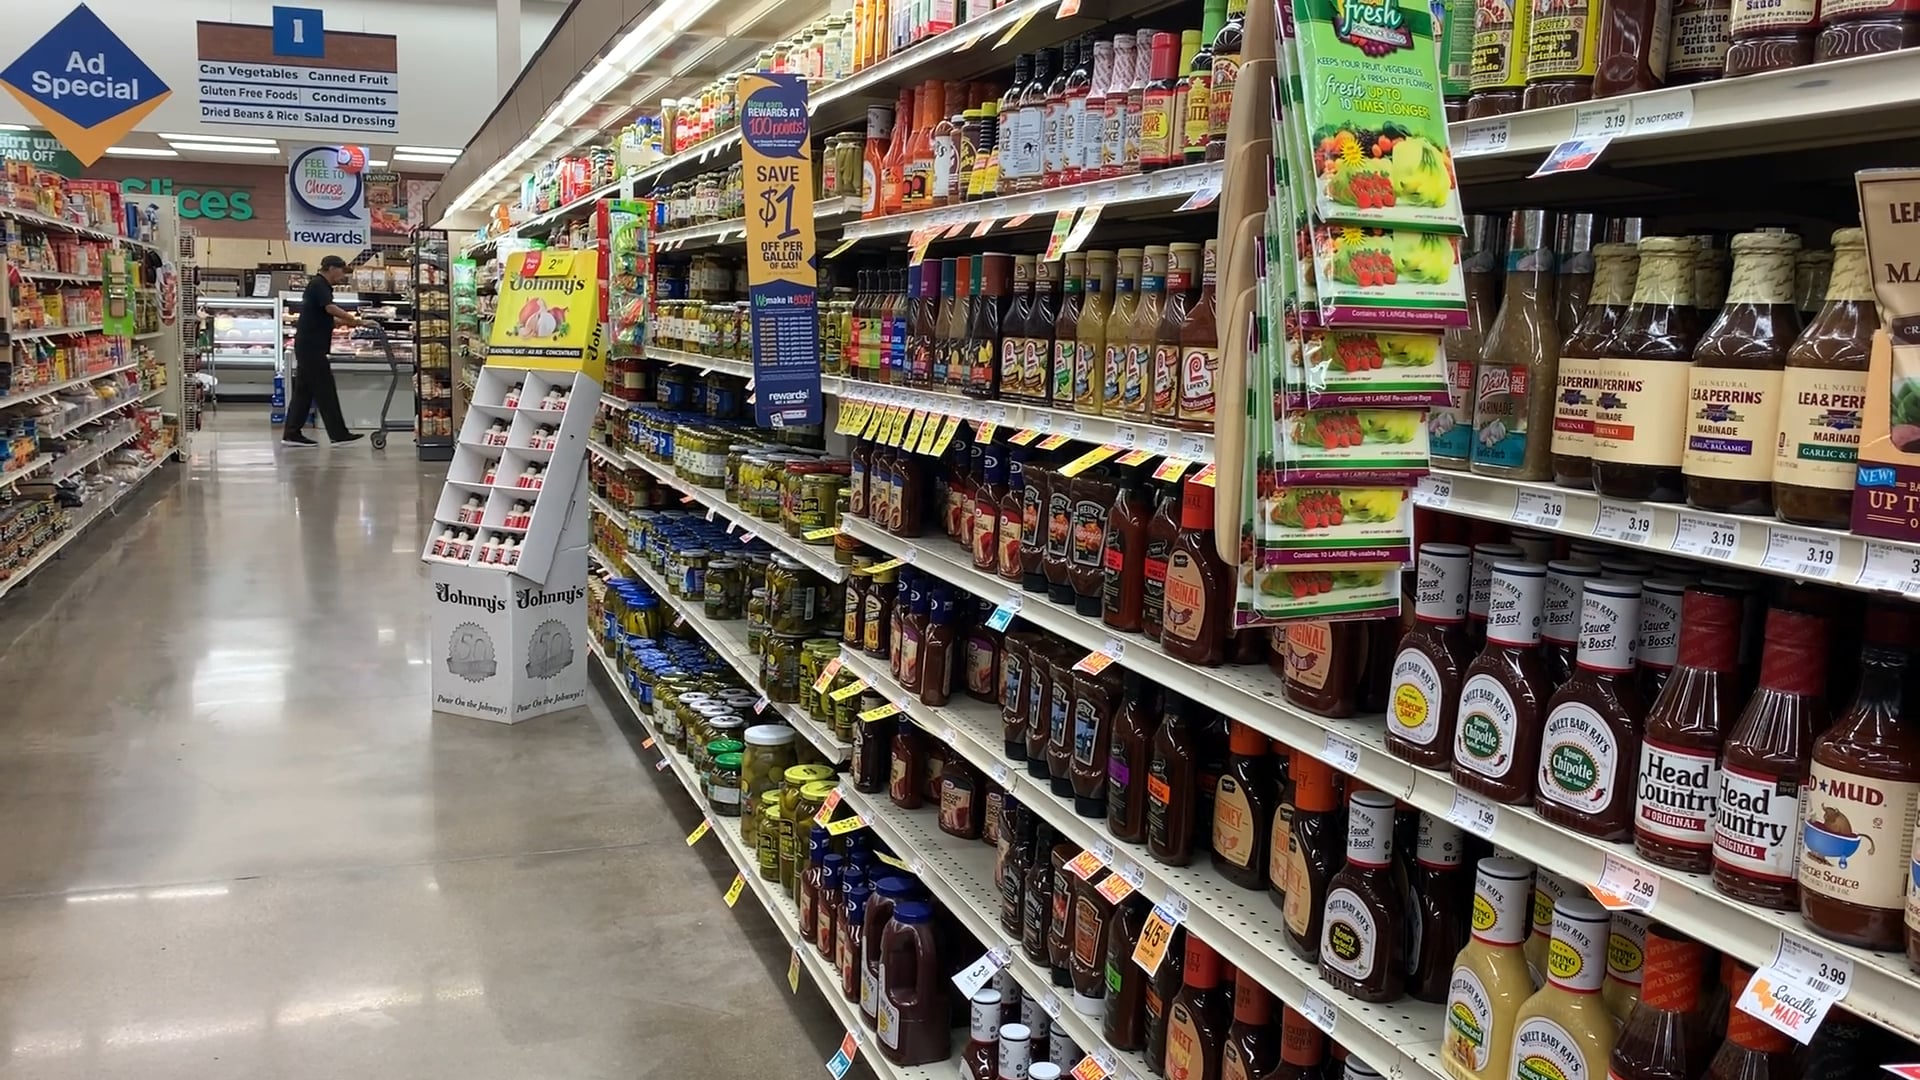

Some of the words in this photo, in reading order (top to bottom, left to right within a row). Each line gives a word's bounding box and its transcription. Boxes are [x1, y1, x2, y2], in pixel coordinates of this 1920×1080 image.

[1342, 0, 1401, 33] fresh
[1684, 46, 1716, 55] Sauce
[65, 51, 105, 74] Ad
[1317, 57, 1339, 66] KEEPS
[1341, 58, 1361, 68] YOUR
[1384, 64, 1423, 76] VEGETABLES
[200, 64, 226, 76] Can
[228, 66, 299, 80] Vegetables
[308, 71, 355, 84] Canned
[358, 74, 389, 86] Fruit
[32, 70, 139, 101] Special
[1322, 74, 1365, 104] fresh
[1367, 87, 1383, 98] UP
[1385, 88, 1402, 100] TO
[1367, 74, 1389, 84] FRESH
[1391, 76, 1404, 86] CUT
[1405, 78, 1434, 91] FLOWERS
[200, 86, 236, 98] Gluten
[239, 88, 262, 98] Free
[265, 89, 299, 101] Foods
[312, 92, 387, 106] Condiments
[201, 106, 231, 118] Dried
[233, 107, 264, 119] Beans
[267, 109, 274, 119] &
[277, 110, 299, 121] Rice
[748, 108, 788, 117] REWARDS
[789, 108, 800, 117] AT
[1340, 98, 1352, 110] 10
[1353, 99, 1385, 114] TIMES
[304, 112, 338, 125] Salad
[341, 115, 396, 129] Dressing
[1605, 115, 1625, 129] 3.19
[1646, 115, 1660, 124] NOT
[1660, 111, 1684, 122] ORDER
[749, 117, 772, 136] 100
[772, 118, 806, 138] points!
[1489, 132, 1507, 145] 3.19
[32, 150, 56, 162] OFF
[305, 159, 327, 168] FEEL
[305, 169, 329, 179] FREE
[331, 170, 344, 179] TO
[757, 166, 799, 182] SAVE
[759, 183, 801, 241] $1
[294, 229, 367, 244] rewards!
[761, 241, 780, 251] OFF
[784, 241, 803, 251] PER
[763, 251, 802, 262] GALLON
[770, 261, 779, 269] OF
[781, 261, 798, 269] GAS!
[766, 296, 786, 305] make
[1378, 310, 1386, 318] 10
[1386, 310, 1406, 318] LARGE
[1434, 313, 1447, 321] Bags
[1458, 370, 1471, 379] SALT
[1512, 376, 1525, 384] SALT
[1458, 379, 1470, 387] FREE
[1511, 385, 1525, 393] FREE
[1710, 380, 1748, 388] NATURAL
[1814, 383, 1828, 391] ALL
[769, 389, 809, 401] rewards!
[1698, 424, 1738, 436] MARINADE
[1710, 443, 1747, 453] BALSAMIC
[1802, 447, 1837, 459] GARLIC
[1838, 450, 1847, 459] &
[1859, 467, 1893, 483] NEW!
[1434, 485, 1450, 496] 2.99
[1869, 490, 1898, 510] UP
[1543, 503, 1562, 516] 3.19
[1628, 517, 1650, 532] 3.19
[1711, 531, 1735, 546] 3.19
[1376, 550, 1390, 558] Bags
[1807, 547, 1834, 565] 3.19
[1418, 578, 1439, 588] Sauce
[436, 583, 506, 614] Johnny's
[516, 585, 585, 609] Johnny's
[1422, 590, 1444, 602] Boss!
[1546, 598, 1568, 608] Sauce
[1492, 599, 1515, 610] Sauce
[1495, 612, 1520, 625] Boss!
[1550, 611, 1574, 623] Boss!
[1584, 622, 1610, 633] Sauce
[1643, 621, 1670, 631] Sauce
[1589, 636, 1616, 649] Boss!
[1648, 633, 1676, 646] Boss!
[455, 697, 465, 706] On
[467, 699, 477, 708] the
[1464, 688, 1478, 706] SWEET
[1480, 688, 1495, 703] BABY
[1494, 697, 1512, 722] RAY'S
[1465, 723, 1497, 747] Chipotle
[1549, 717, 1568, 736] SWEET
[1570, 718, 1589, 736] BABY
[1589, 726, 1611, 753] RAY'S
[1344, 750, 1358, 763] 1.99
[1563, 747, 1583, 763] Honey
[1552, 754, 1593, 781] Chipotle
[1648, 753, 1709, 789] Head
[1638, 772, 1717, 817] Country
[1718, 776, 1770, 815] Head
[1478, 810, 1494, 825] 1.99
[1651, 811, 1698, 829] ORIGINAL
[1717, 835, 1757, 857] ORIGINAL
[1633, 878, 1654, 897] 2.99
[1823, 871, 1859, 890] Sauce
[1819, 963, 1846, 985] 3.99
[1773, 985, 1817, 1024] Locally
[1323, 1006, 1336, 1021] 1.99
[1771, 1003, 1804, 1030] MADE
[1520, 1031, 1539, 1046] SWEET
[1541, 1032, 1561, 1049] BABY
[1560, 1045, 1581, 1072] RAY'S
